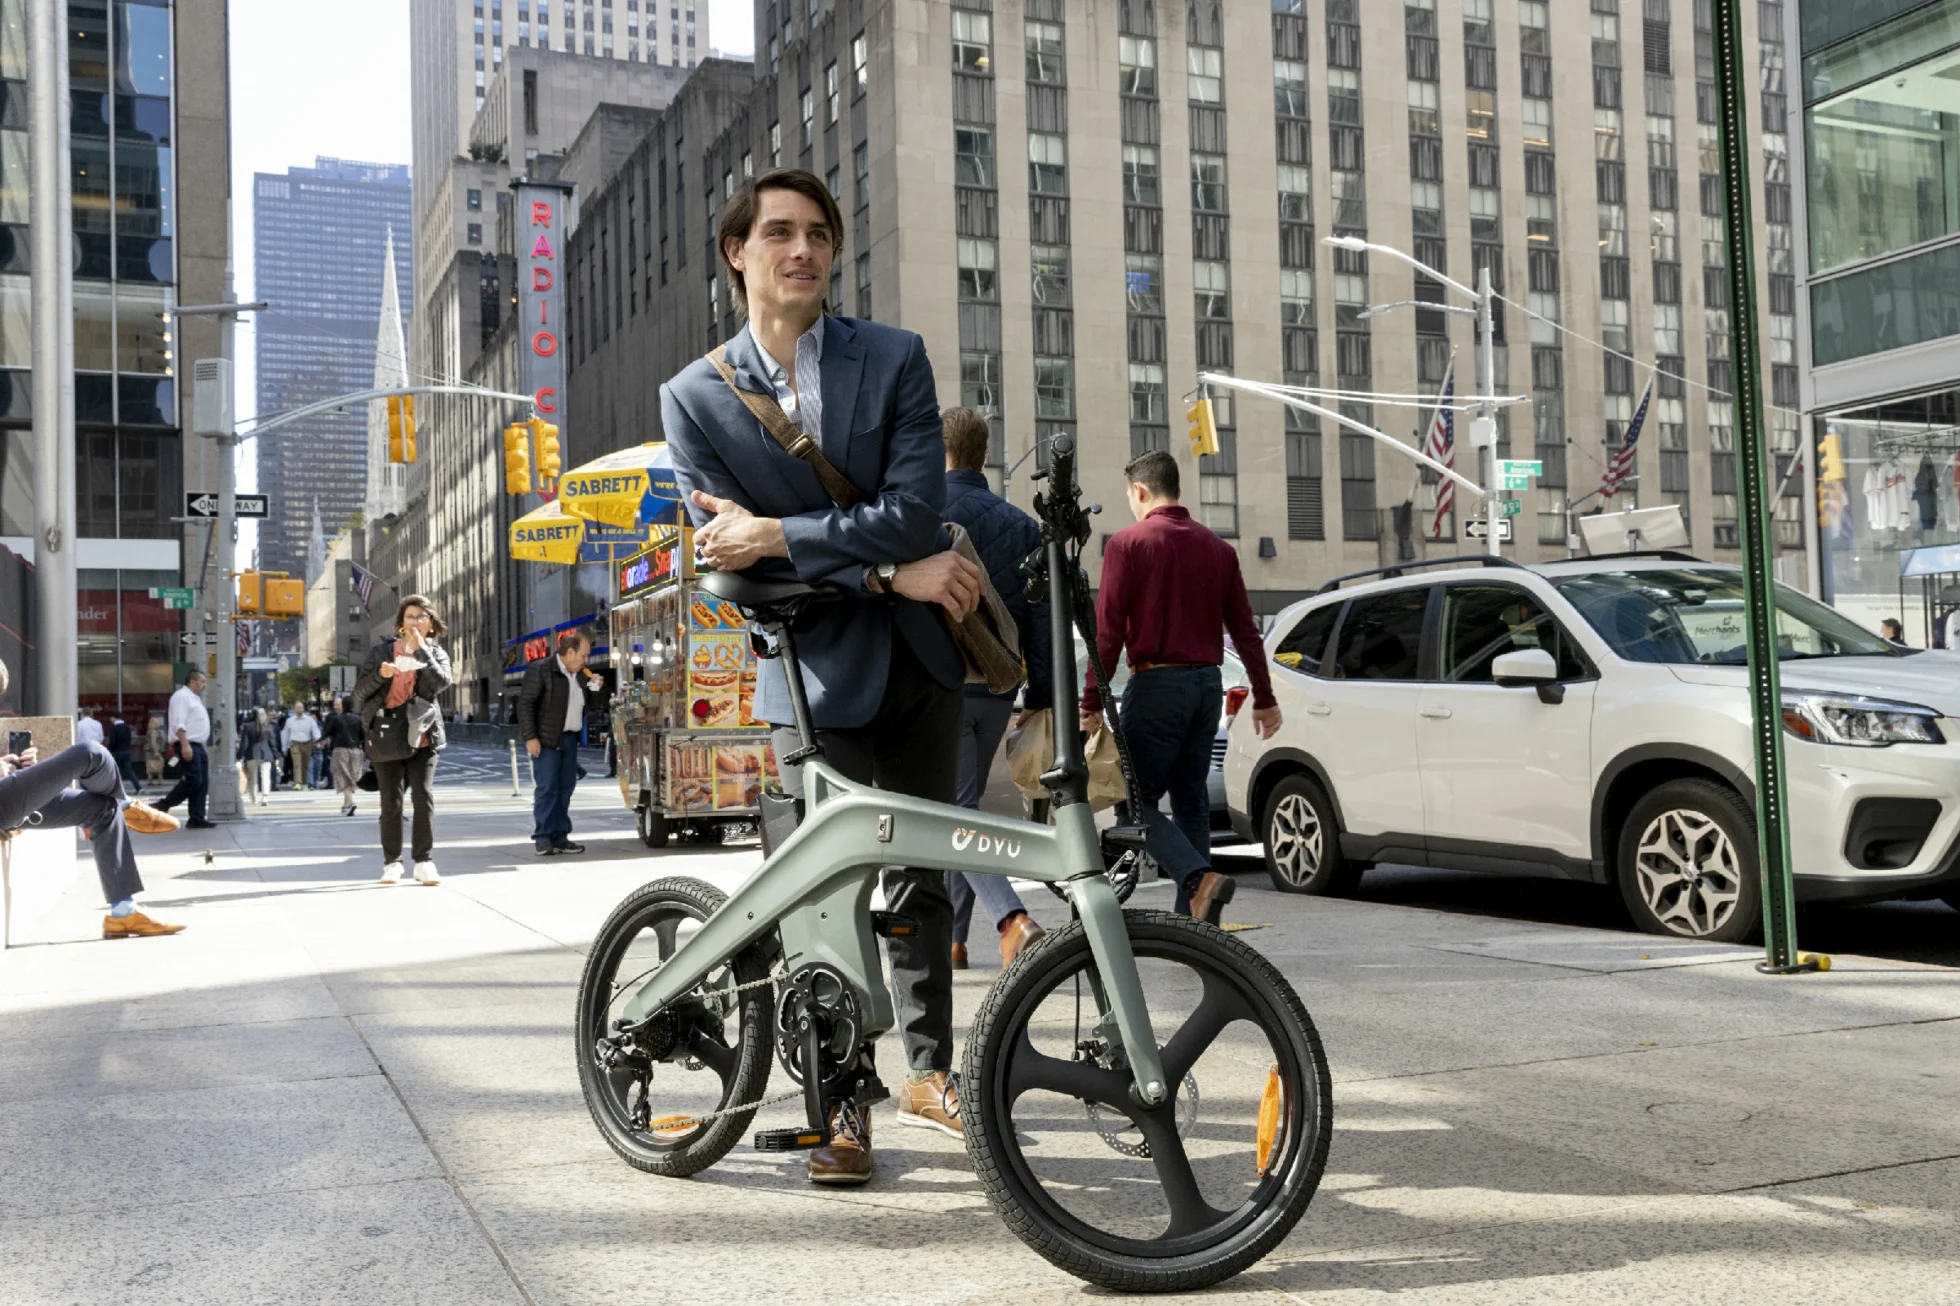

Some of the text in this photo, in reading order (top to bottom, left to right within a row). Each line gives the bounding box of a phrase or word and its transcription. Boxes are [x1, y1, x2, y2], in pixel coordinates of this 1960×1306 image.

[531, 201, 557, 357] RADIO
[565, 475, 642, 497] SABRETT
[235, 502, 258, 511] WAY
[515, 525, 579, 542] SABRETT
[77, 606, 108, 620] nder
[1694, 624, 1741, 636] Merchants
[1791, 633, 1811, 643] Merc
[977, 834, 1022, 858] DYU
